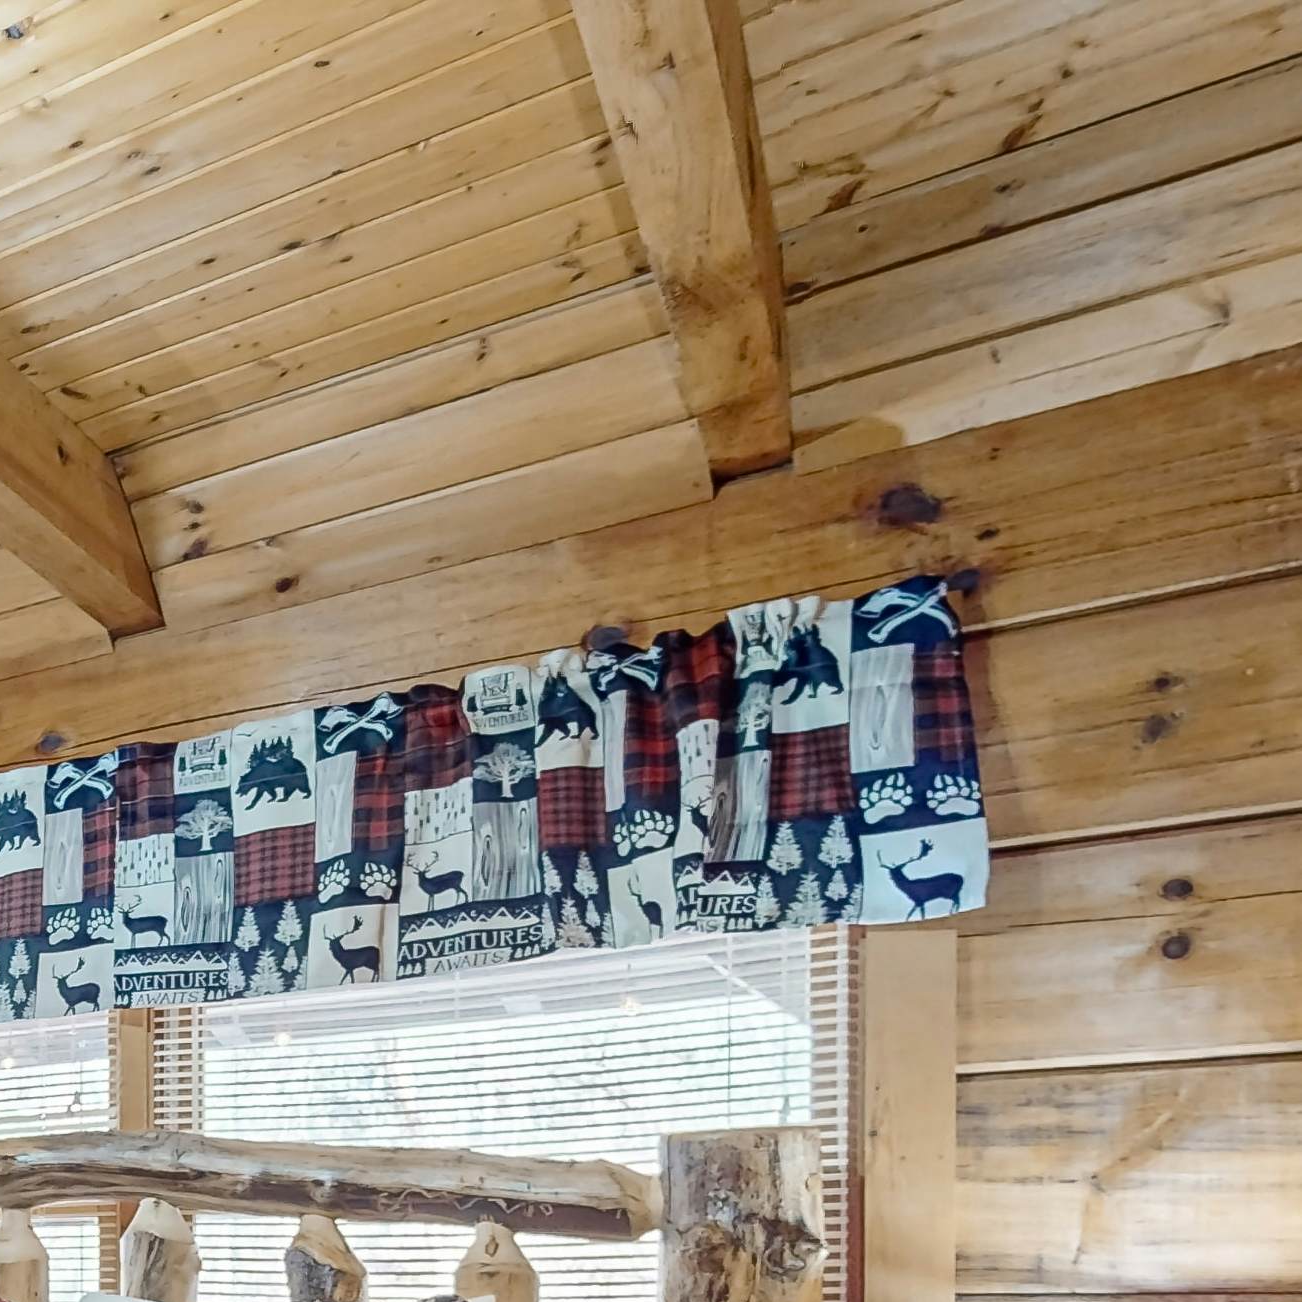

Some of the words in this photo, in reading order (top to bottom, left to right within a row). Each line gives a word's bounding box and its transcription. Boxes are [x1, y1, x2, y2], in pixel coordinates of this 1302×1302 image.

[398, 924, 544, 962] ADVENTURES
[433, 952, 505, 973] AWAITS
[136, 991, 200, 1005] AWAITS
